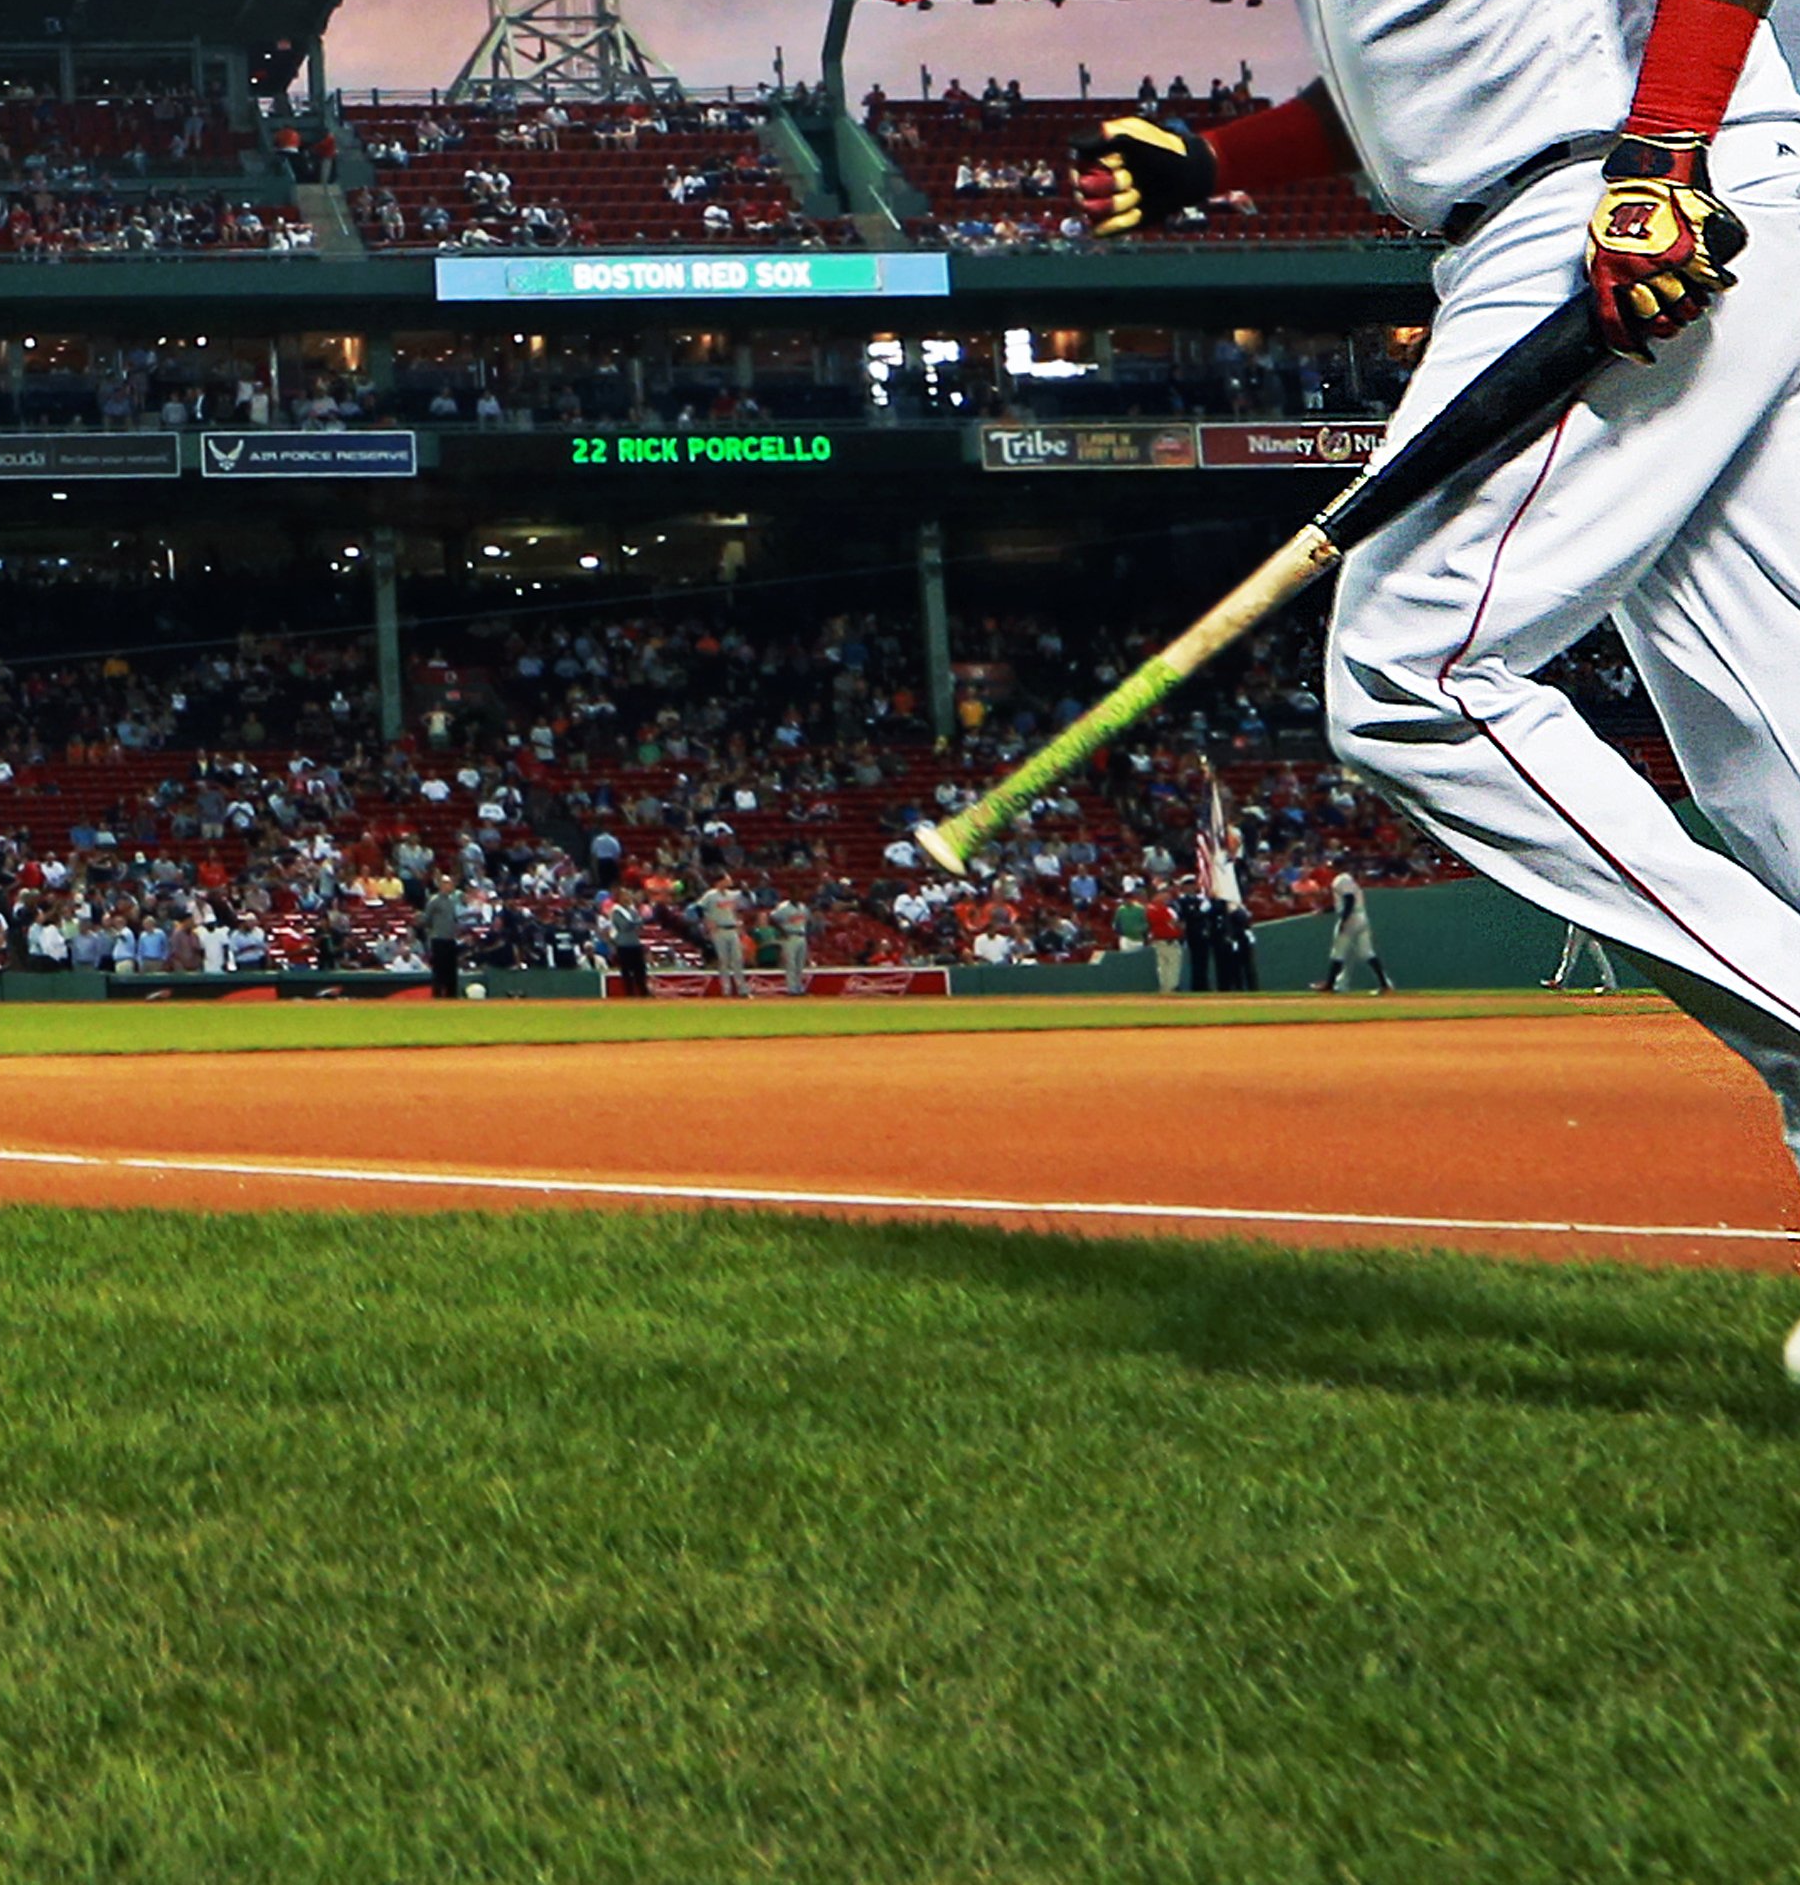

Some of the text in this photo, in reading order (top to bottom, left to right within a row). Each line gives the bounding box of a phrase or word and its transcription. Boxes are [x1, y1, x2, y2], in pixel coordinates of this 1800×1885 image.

[573, 261, 811, 289] BOSTON RED SOX
[572, 436, 831, 463] 22 RICK PORCELLO
[988, 431, 1068, 464] Tribe
[1248, 435, 1315, 456] Ninety
